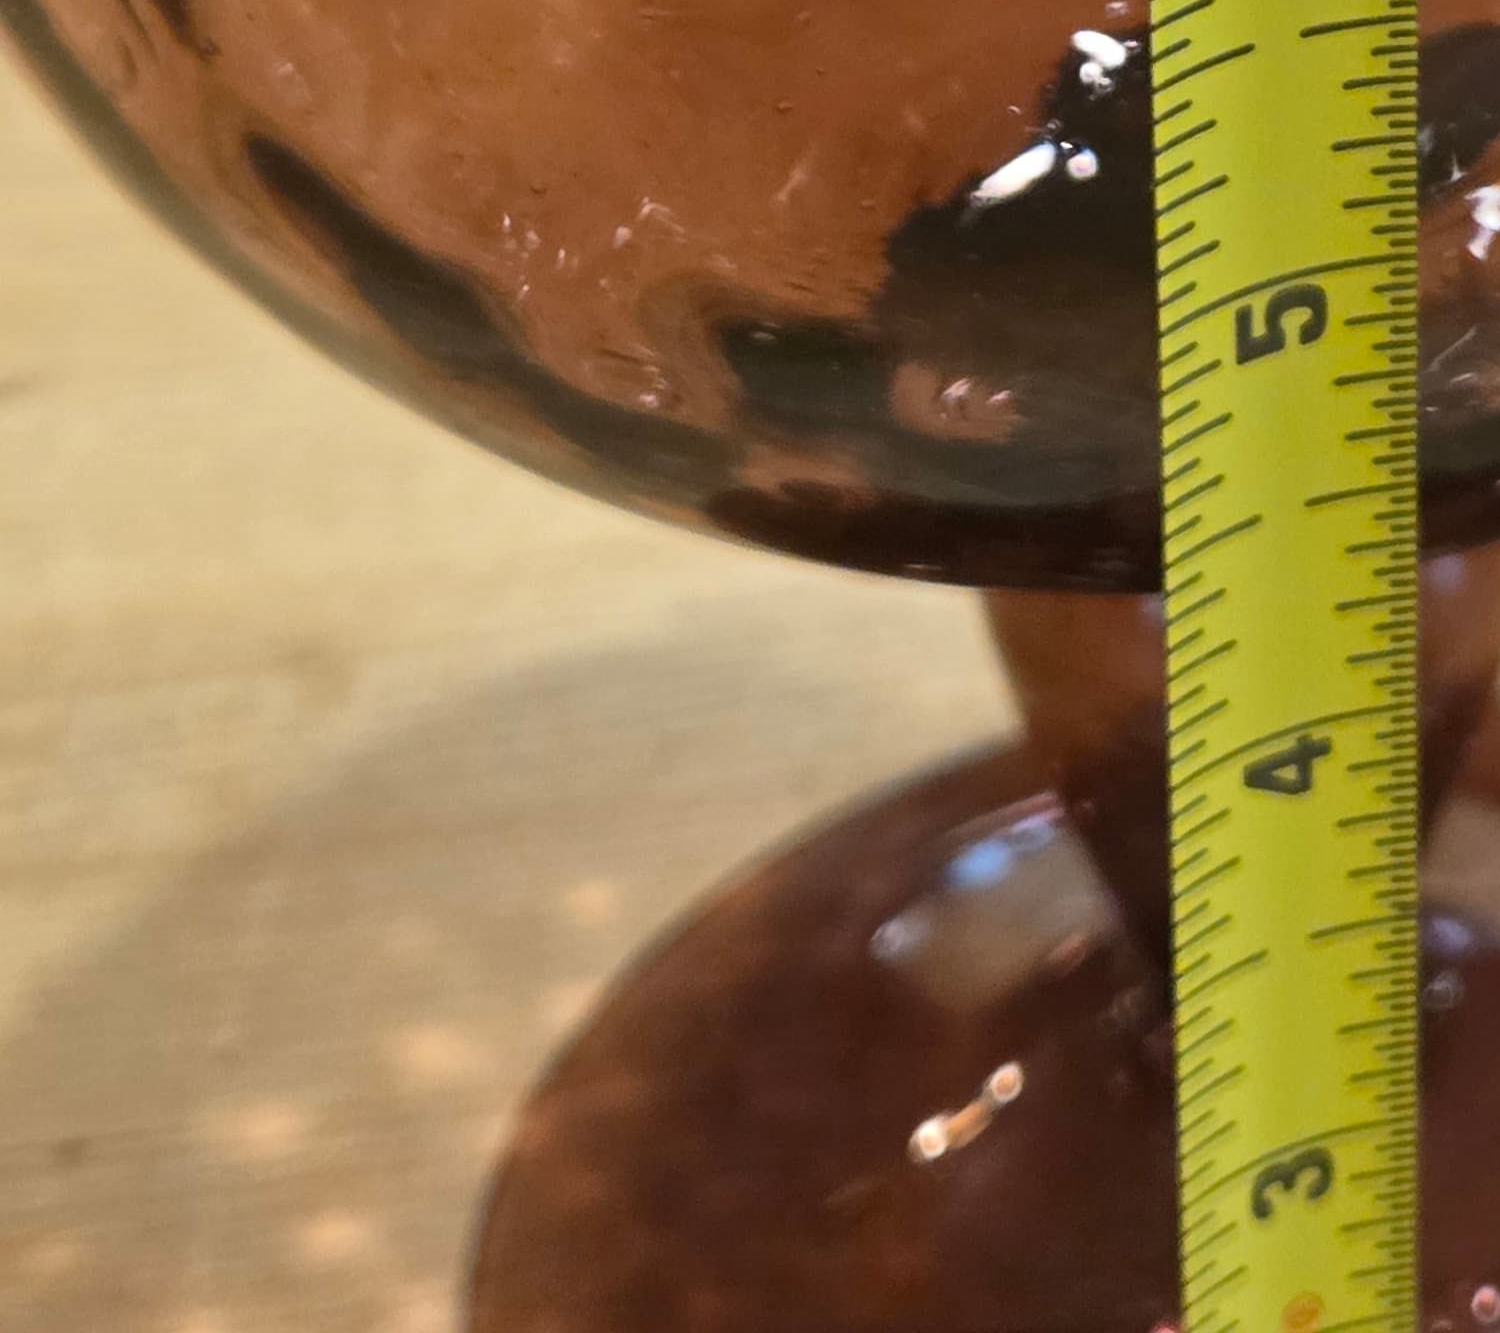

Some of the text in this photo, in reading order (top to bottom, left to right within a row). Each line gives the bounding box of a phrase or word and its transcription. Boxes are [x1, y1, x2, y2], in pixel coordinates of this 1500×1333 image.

[1235, 284, 1328, 366] 5
[1243, 734, 1332, 796] 4
[1252, 1146, 1335, 1220] 3
